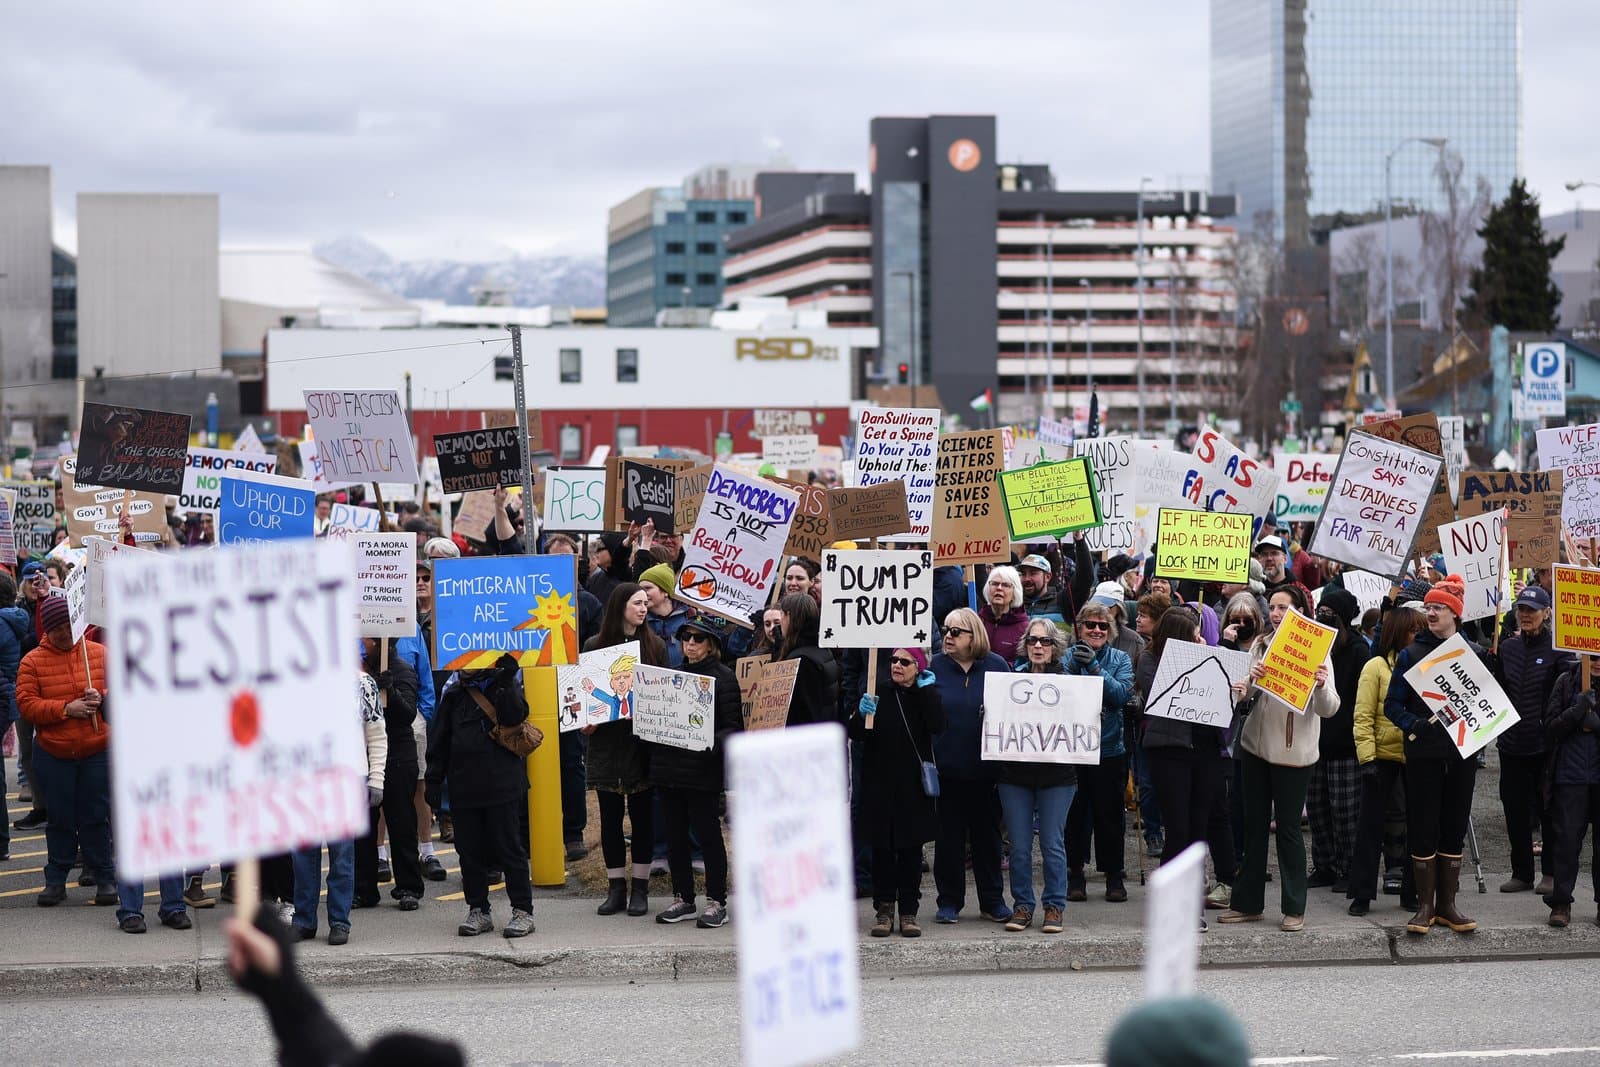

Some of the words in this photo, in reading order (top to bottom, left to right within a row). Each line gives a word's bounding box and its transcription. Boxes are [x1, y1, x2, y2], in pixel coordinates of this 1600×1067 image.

[1530, 382, 1557, 390] PUBLIC
[308, 392, 342, 419] STOP
[344, 392, 402, 418] FASCISM
[1528, 392, 1562, 400] PARKING
[346, 422, 362, 434] IN
[890, 432, 898, 440] a
[1559, 426, 1598, 445] WTF
[320, 438, 404, 476] AMERICA
[454, 454, 466, 464] IS
[472, 450, 493, 464] NOT
[500, 450, 506, 460] A
[859, 442, 875, 455] Do
[878, 443, 904, 456] Your
[908, 443, 931, 456] Job
[186, 454, 274, 474] DEMOCRACY
[858, 458, 902, 472] Uphold
[906, 459, 932, 472] The:
[1029, 467, 1048, 480] BELL
[98, 463, 183, 486] BALANCES
[197, 476, 220, 490] NO
[444, 472, 498, 490] SPECTATOR
[910, 475, 934, 488] Law
[1372, 468, 1406, 488] SAYS
[38, 487, 49, 498] IS
[945, 486, 990, 502] SAVES
[1464, 473, 1550, 500] ALASKA
[232, 481, 306, 516] UPHOLD
[708, 470, 796, 524] DEMOCRACY
[832, 493, 848, 506] NO
[856, 488, 900, 500] TAXATION
[1040, 490, 1056, 504] THE
[1340, 479, 1417, 514] DETAINEES
[77, 507, 103, 517] Gov't
[850, 502, 888, 514] WITHOUT
[946, 503, 990, 519] LIVES
[1034, 502, 1054, 514] MUST
[1056, 500, 1076, 512] STOP
[1101, 494, 1124, 519] UE
[248, 510, 282, 530] OUR
[711, 501, 735, 520] IS
[736, 512, 776, 538] NOT
[1162, 512, 1183, 526] IF
[1190, 514, 1208, 528] HE
[1214, 516, 1248, 530] ONLY
[1360, 506, 1392, 524] GET
[1395, 516, 1406, 530] A
[692, 528, 743, 561] REALITY
[726, 528, 737, 543] A
[1083, 521, 1134, 549] ROCESS
[1162, 532, 1187, 546] HAD
[1190, 534, 1198, 546] A
[1202, 534, 1249, 549] BRAIN!
[1330, 518, 1362, 544] FAIR
[1366, 530, 1405, 557] TRIAL
[1451, 521, 1488, 556] NO
[705, 556, 774, 590] SHOW!
[1158, 555, 1188, 568] LOCK
[1192, 556, 1218, 570] HIM
[1226, 558, 1248, 573] UP!
[438, 574, 552, 597] IMMIGRANTS
[1558, 570, 1578, 583] SOCIAL
[380, 586, 402, 594] RIGHT
[1561, 592, 1576, 604] CUTS
[1578, 594, 1590, 606] FOR
[474, 602, 508, 622] ARE
[832, 596, 928, 627] TRUMP
[1562, 613, 1573, 626] TAX
[1576, 615, 1590, 628] CUTS
[121, 579, 345, 692] RESIST
[442, 630, 550, 650] COMMUNITY
[741, 661, 754, 678] IF
[1010, 678, 1060, 706] GO
[1179, 676, 1213, 697] Denali
[1450, 662, 1480, 696] HANDS
[1478, 699, 1496, 719] OFF
[1167, 696, 1219, 724] Forever
[1434, 675, 1482, 732] DEMOCRACY
[984, 721, 1099, 753] HARVARD
